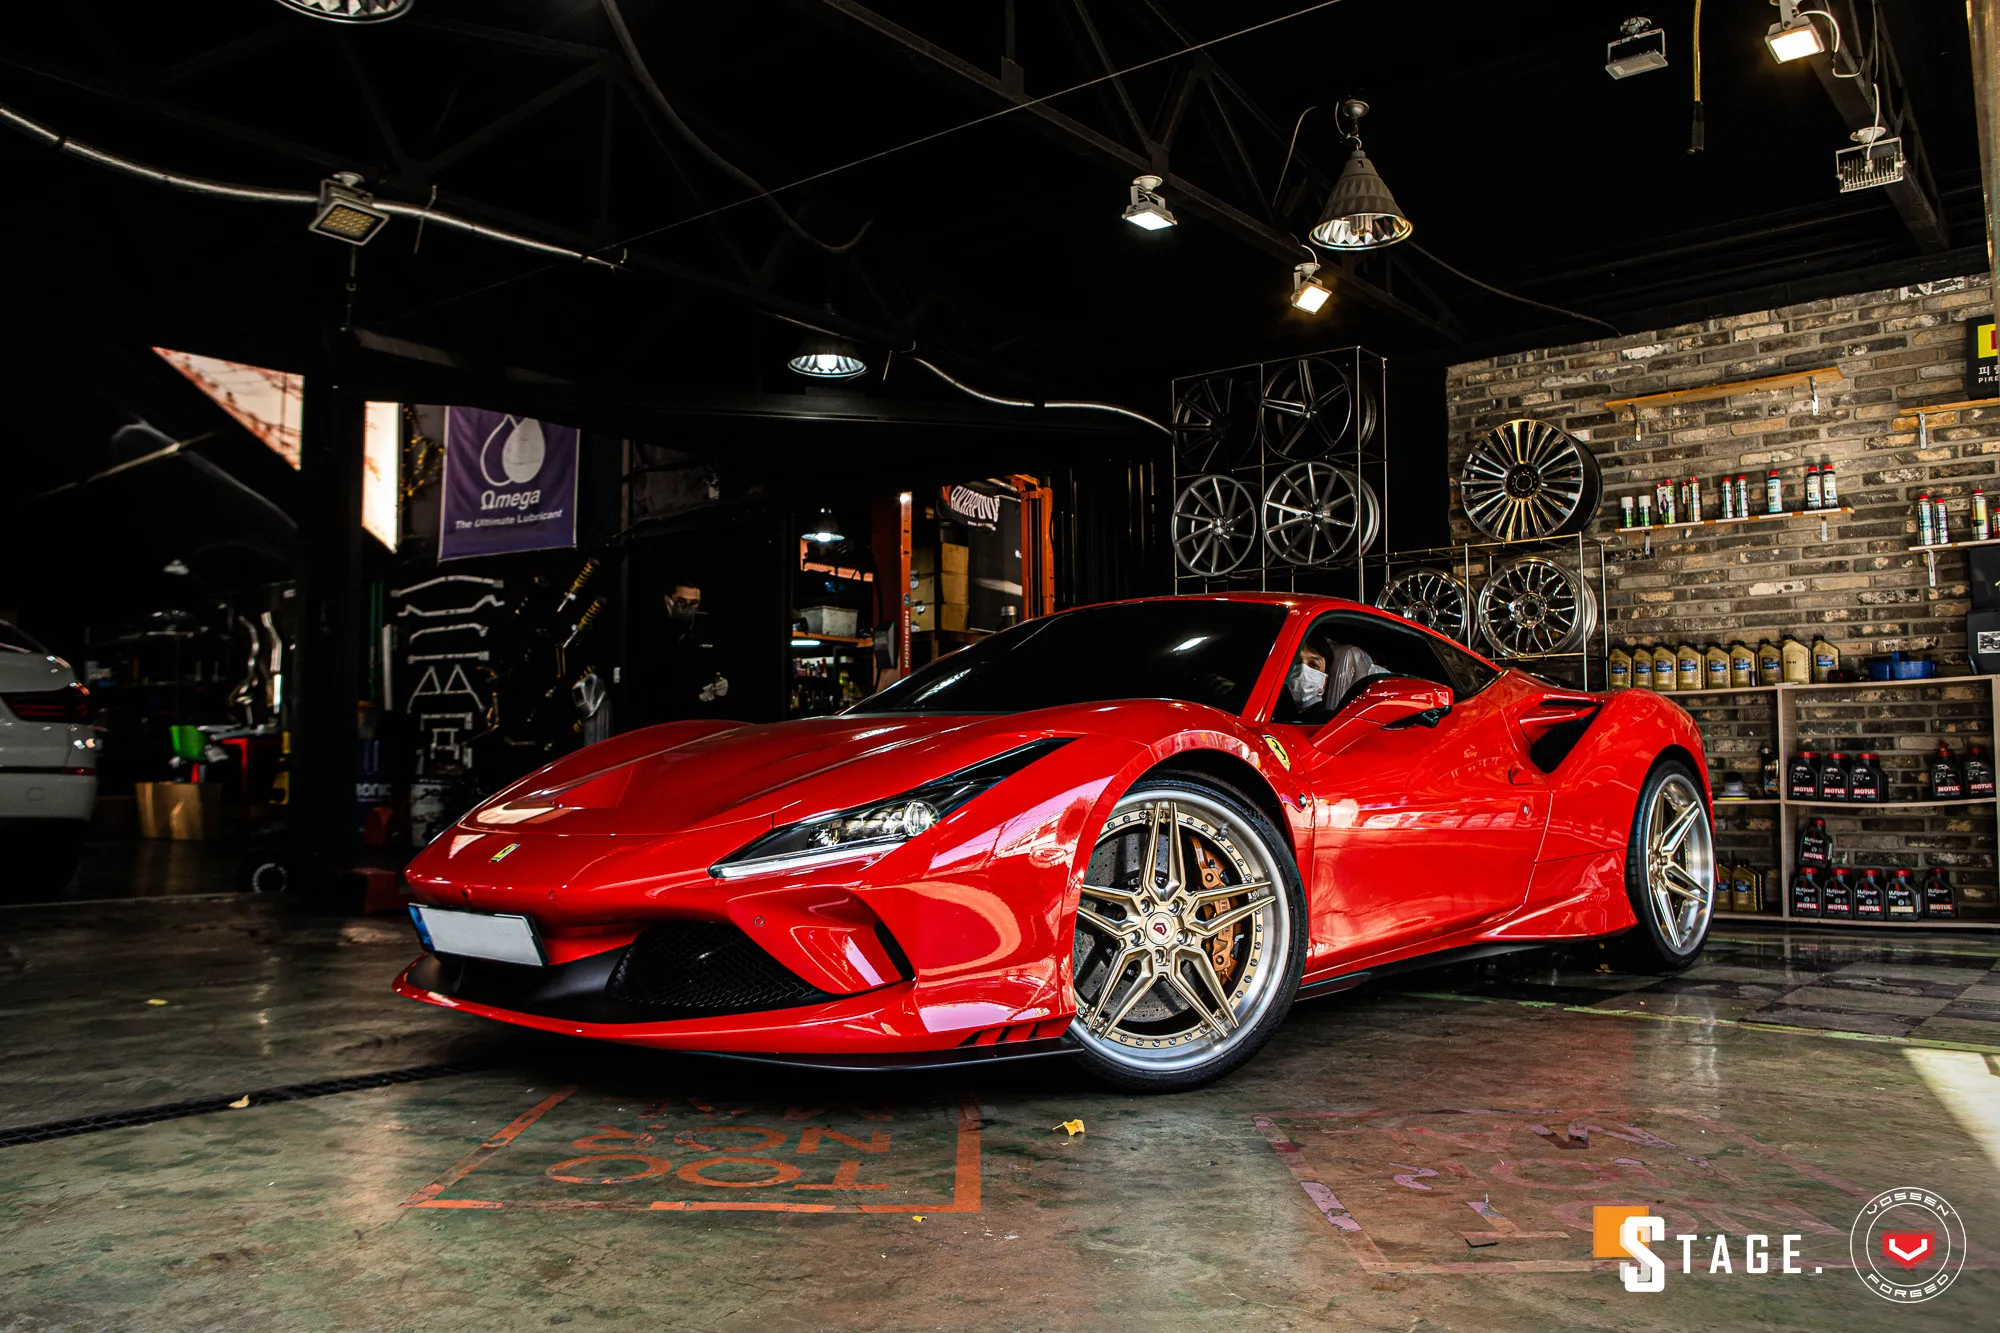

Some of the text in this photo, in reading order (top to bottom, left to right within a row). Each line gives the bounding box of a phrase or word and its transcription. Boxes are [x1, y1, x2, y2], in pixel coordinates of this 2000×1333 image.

[454, 509, 563, 529] The Ultimate Lubricant
[1803, 852, 1823, 860] MOTUL
[545, 1154, 890, 1191] TOO
